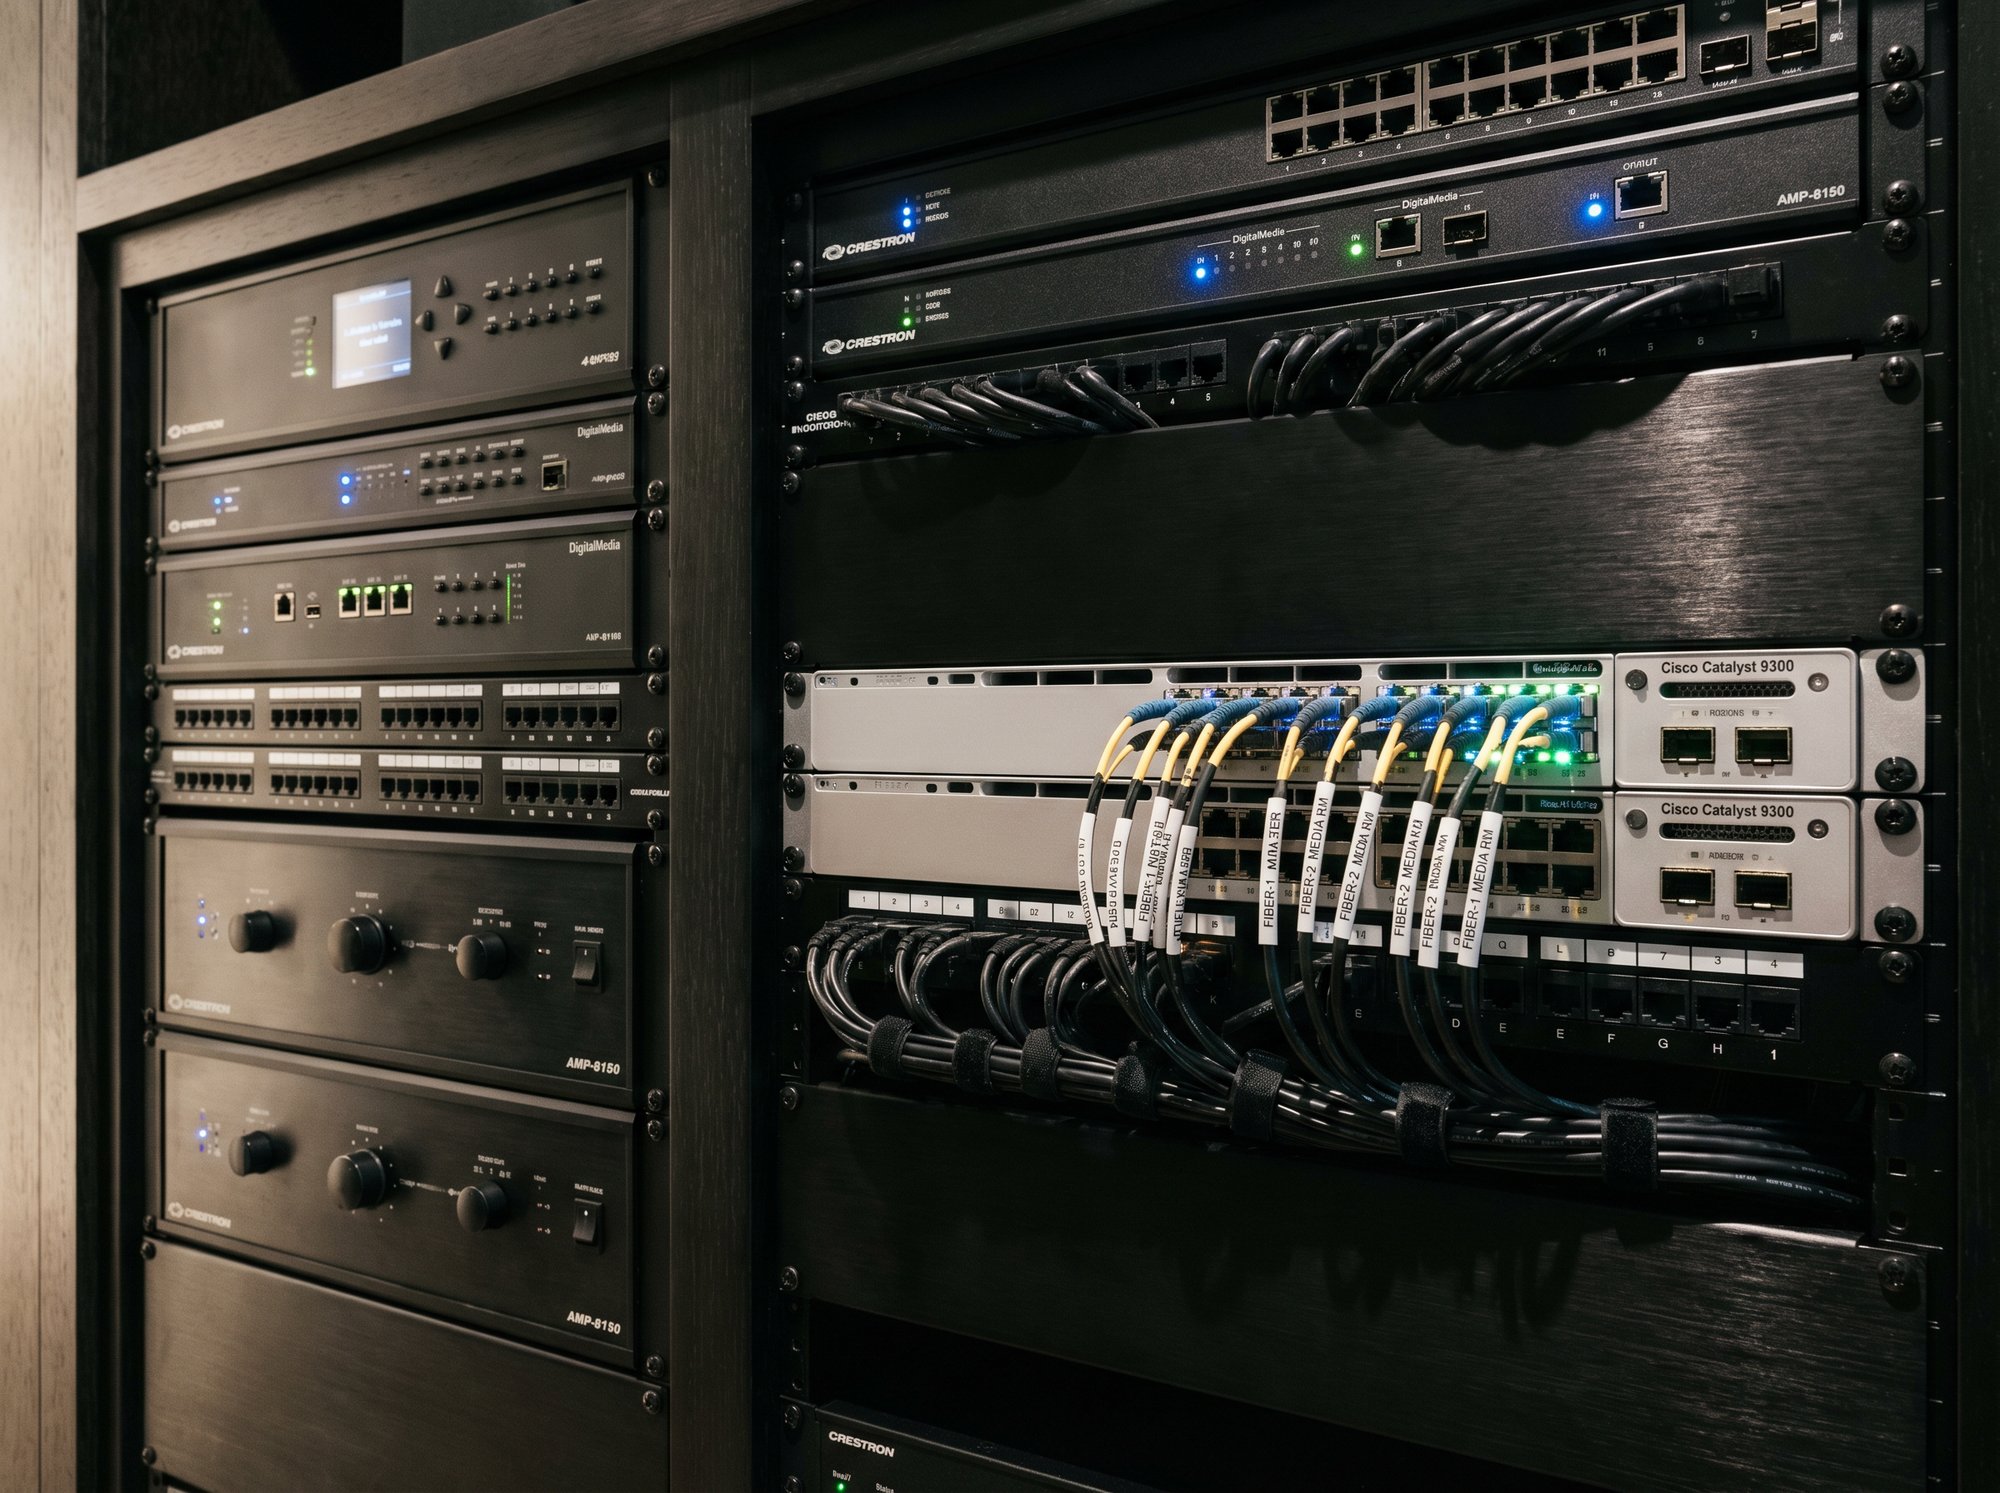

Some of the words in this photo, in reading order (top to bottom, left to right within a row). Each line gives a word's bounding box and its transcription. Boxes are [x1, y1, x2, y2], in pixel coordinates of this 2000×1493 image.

[1402, 192, 1458, 209] DigitalMedia
[1777, 184, 1846, 206] AMP-8150
[846, 232, 916, 255] CRESTRON
[1229, 251, 1235, 259] 2
[846, 329, 916, 350] CRESTRON
[577, 422, 624, 439] DigitalMedia
[569, 539, 620, 556] DigitalMedia
[1661, 661, 1698, 674] Cisco
[1702, 660, 1757, 676] Catalyst
[1760, 659, 1794, 673] 9300
[1316, 797, 1329, 817] RM
[1661, 802, 1698, 815] Cisco
[1702, 803, 1757, 819] Catalyst
[1760, 805, 1794, 818] 9300
[1308, 820, 1325, 860] MEDIA
[1480, 829, 1494, 851] RM
[1402, 840, 1419, 879] MEDIA
[1472, 852, 1490, 893] MEDIA
[1300, 866, 1316, 915] FIBER-2
[1340, 871, 1360, 921] FIBER-2
[923, 900, 929, 908] 3
[1263, 880, 1275, 928] FIBER-1
[1394, 884, 1411, 937] FIBER-2
[1422, 896, 1438, 948] FIBER-2
[1462, 898, 1481, 950] FIBER-1
[1498, 941, 1507, 950] Q
[1556, 944, 1563, 954] L
[1660, 951, 1668, 961] 7
[1714, 956, 1722, 965] 3
[1770, 960, 1778, 969] 4
[1452, 1018, 1460, 1028] D
[1499, 1023, 1507, 1033] E
[1556, 1028, 1564, 1039] E
[1608, 1033, 1615, 1043] F
[1658, 1038, 1668, 1049] G
[1713, 1043, 1723, 1054] H
[1771, 1049, 1777, 1060] 1
[566, 1057, 621, 1075] AMP-8150
[828, 1431, 895, 1457] CRESTRON
